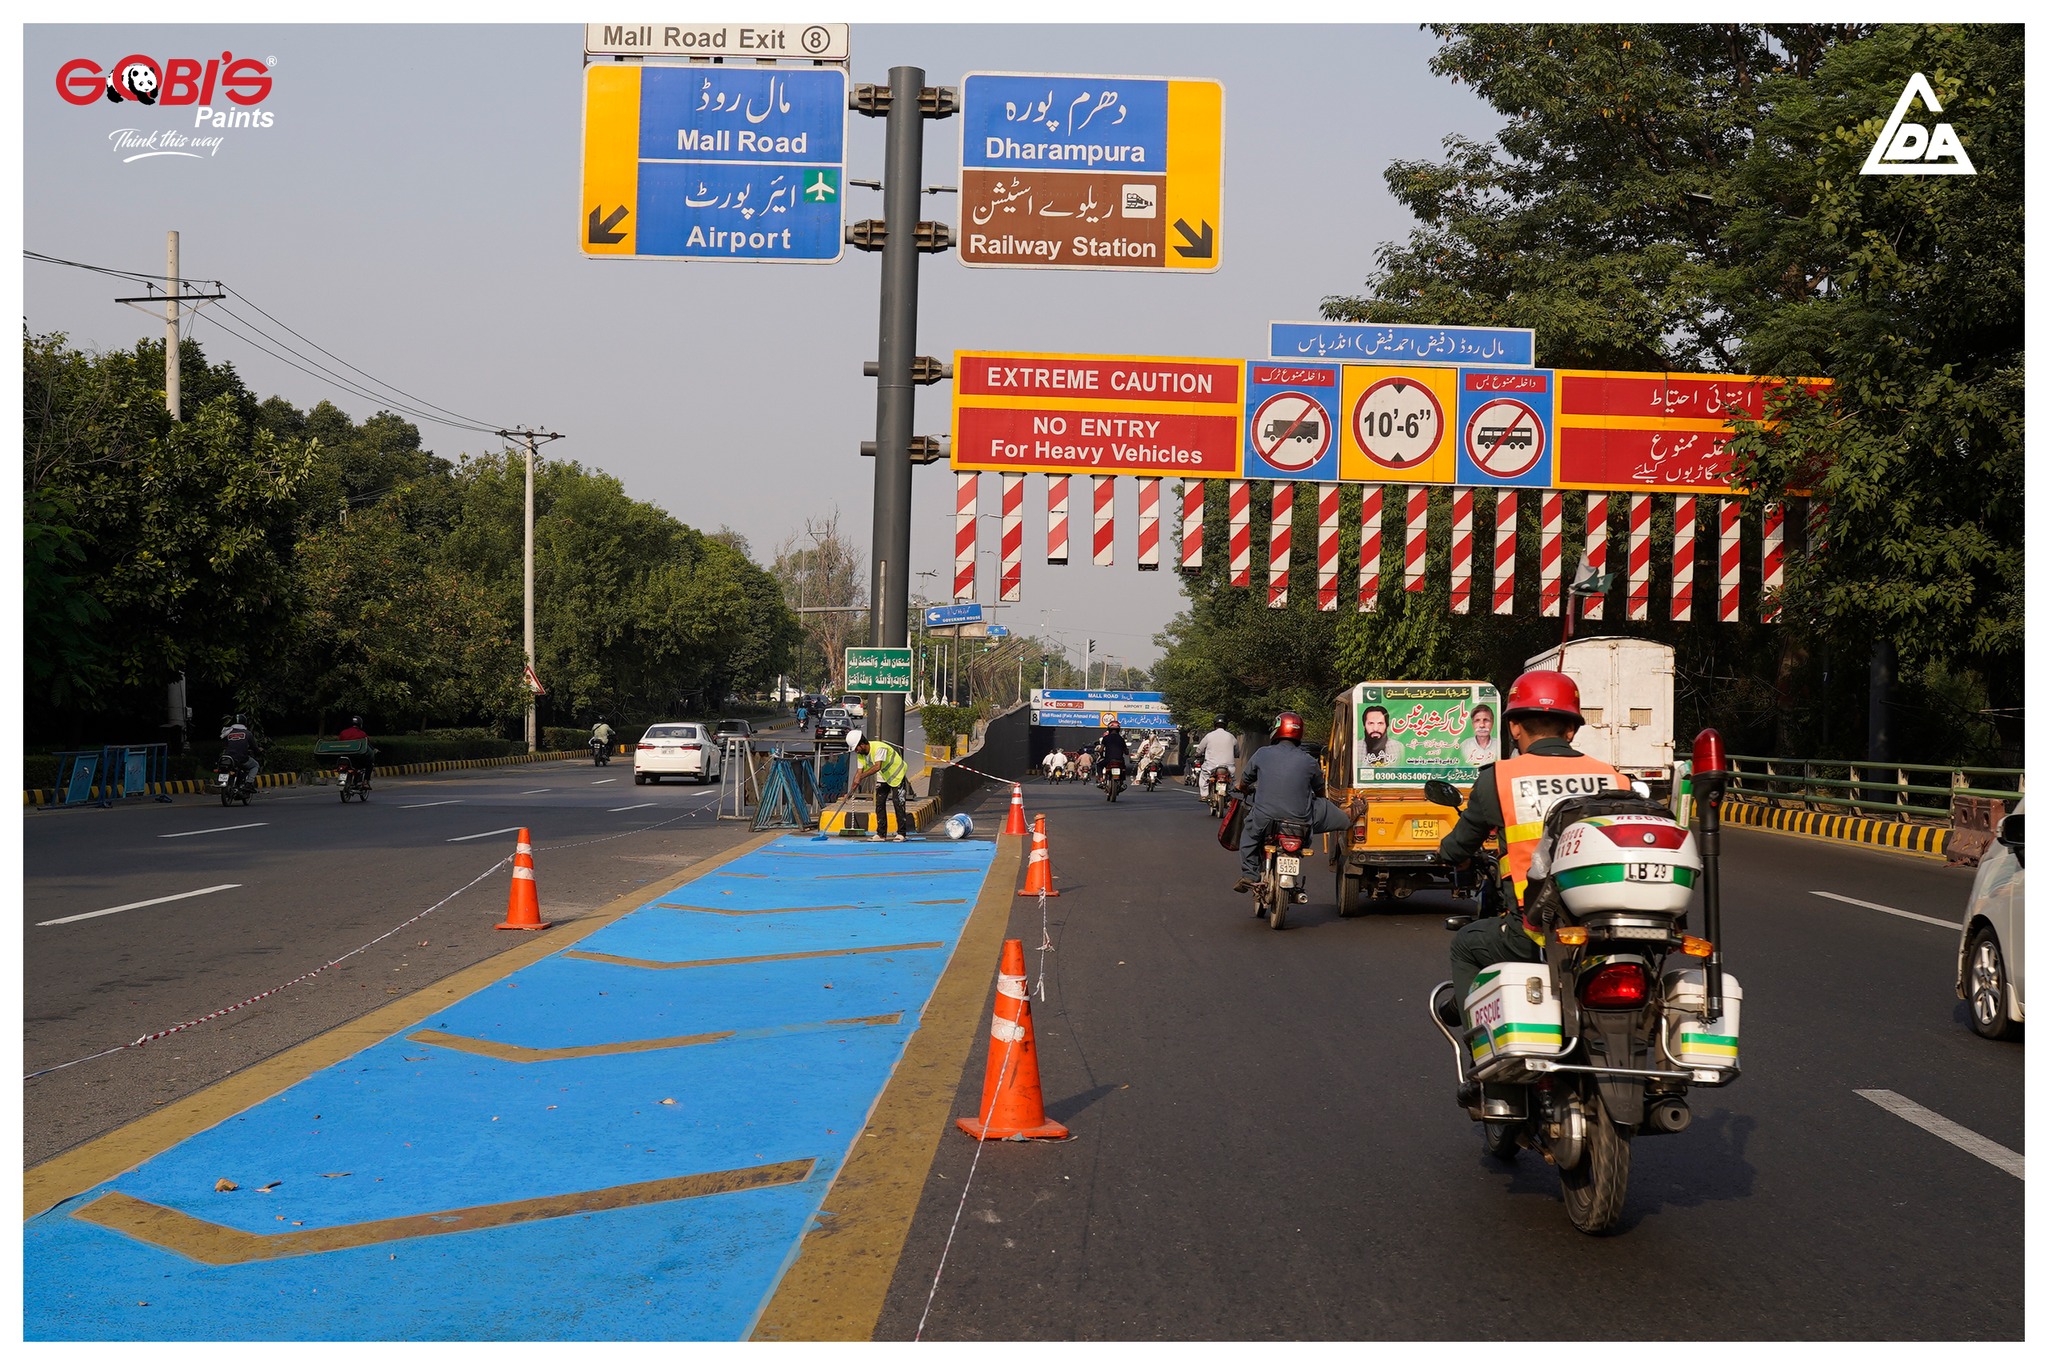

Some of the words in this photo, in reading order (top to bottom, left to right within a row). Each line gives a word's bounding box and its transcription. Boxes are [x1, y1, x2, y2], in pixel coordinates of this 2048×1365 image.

[604, 26, 651, 47] Mall
[664, 27, 726, 48] Road
[739, 29, 785, 49] Exit
[810, 32, 822, 48] 8
[696, 77, 741, 112] روڈ
[746, 76, 790, 123] مال
[1006, 90, 1059, 132] پورہ
[1067, 90, 1127, 137] دھرم
[678, 129, 729, 151] Mall
[738, 132, 807, 153] Road
[986, 137, 1145, 166] Dharampura
[685, 182, 755, 219] پورٹ
[972, 177, 1033, 225] اسٹیشن
[1038, 185, 1114, 223] ریلوے
[686, 225, 791, 252] Airport
[970, 234, 1062, 260] Railway
[1072, 236, 1156, 258] Station
[1298, 334, 1326, 357] پاس
[1328, 334, 1352, 349] انڈر
[1393, 337, 1415, 352] احمد
[1459, 337, 1480, 354] روڈ
[1482, 338, 1504, 359] مال
[987, 367, 1099, 390] EXTREME
[1110, 370, 1212, 394] CAUTION
[1261, 367, 1281, 382] ٹرک
[1281, 368, 1305, 383] ممنوع
[1302, 370, 1326, 382] داخلہ
[1476, 375, 1490, 390] بس
[1492, 375, 1516, 390] ممنوع
[1515, 377, 1536, 389] داخلہ
[1650, 388, 1698, 414] احتیاط
[1033, 417, 1067, 435] NO
[1081, 418, 1161, 439] ENTRY
[991, 439, 1028, 458] For
[1035, 441, 1104, 464] Heavy
[1111, 443, 1203, 464] Vehicles
[1650, 433, 1699, 461] ممنوع
[1423, 705, 1459, 731] رکشہ
[1448, 700, 1469, 735] ملی
[1375, 772, 1432, 780] 0300-3654067
[1520, 777, 1608, 798] RESCUE
[1556, 840, 1581, 859] 1122
[1628, 863, 1648, 879] LB
[1654, 864, 1667, 879] 29
